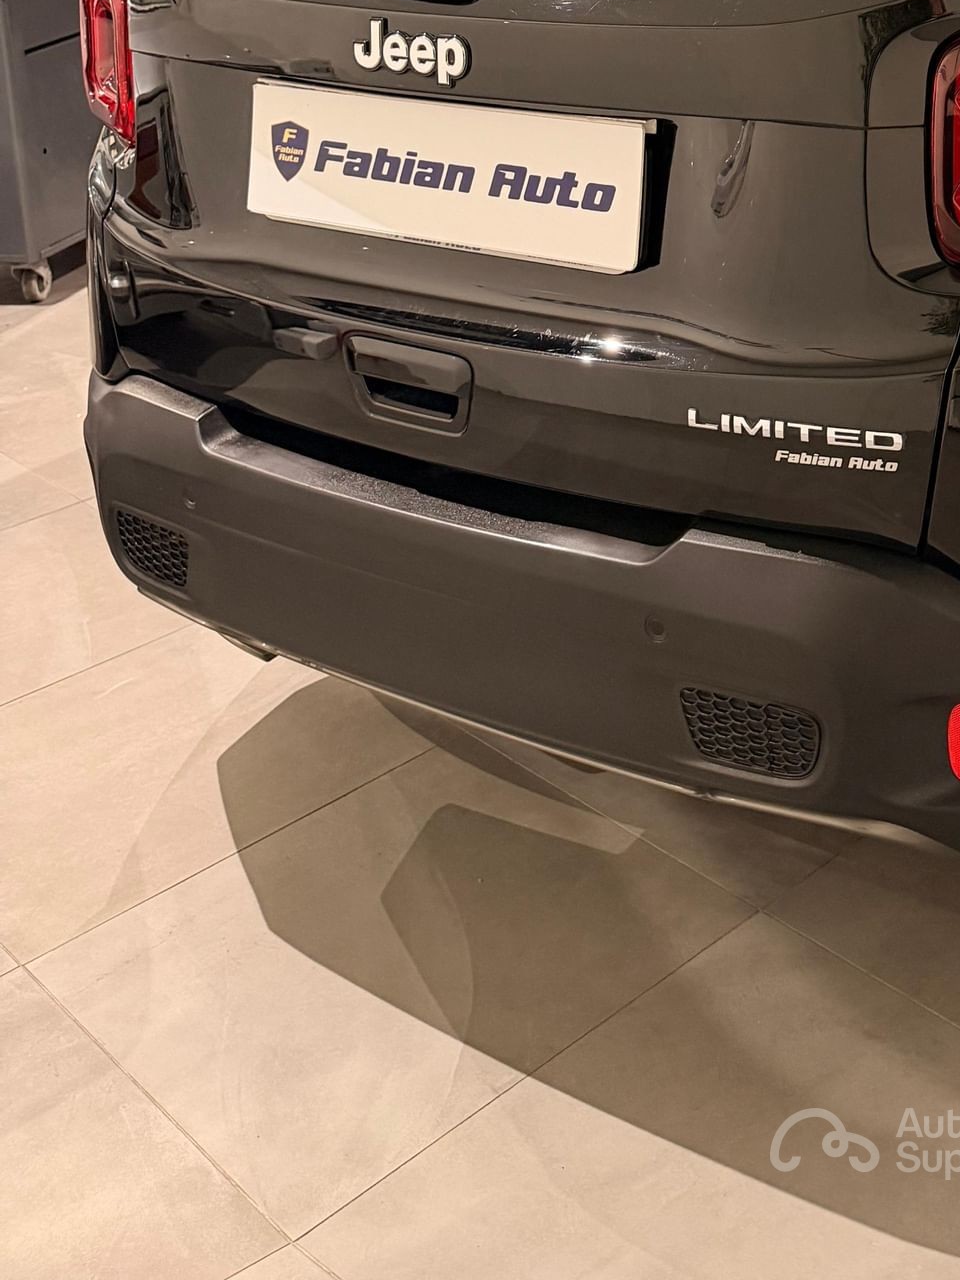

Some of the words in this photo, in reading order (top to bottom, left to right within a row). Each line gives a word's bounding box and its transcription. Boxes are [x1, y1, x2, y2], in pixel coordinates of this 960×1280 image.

[353, 17, 470, 87] Jeep
[282, 128, 297, 143] F
[275, 144, 304, 156] Fabian
[278, 153, 300, 163] Auto
[314, 139, 475, 194] Fabian
[488, 163, 616, 213] Auto
[687, 407, 904, 452] LIMITED
[775, 449, 843, 468] Fabian
[848, 456, 899, 472] Auto
